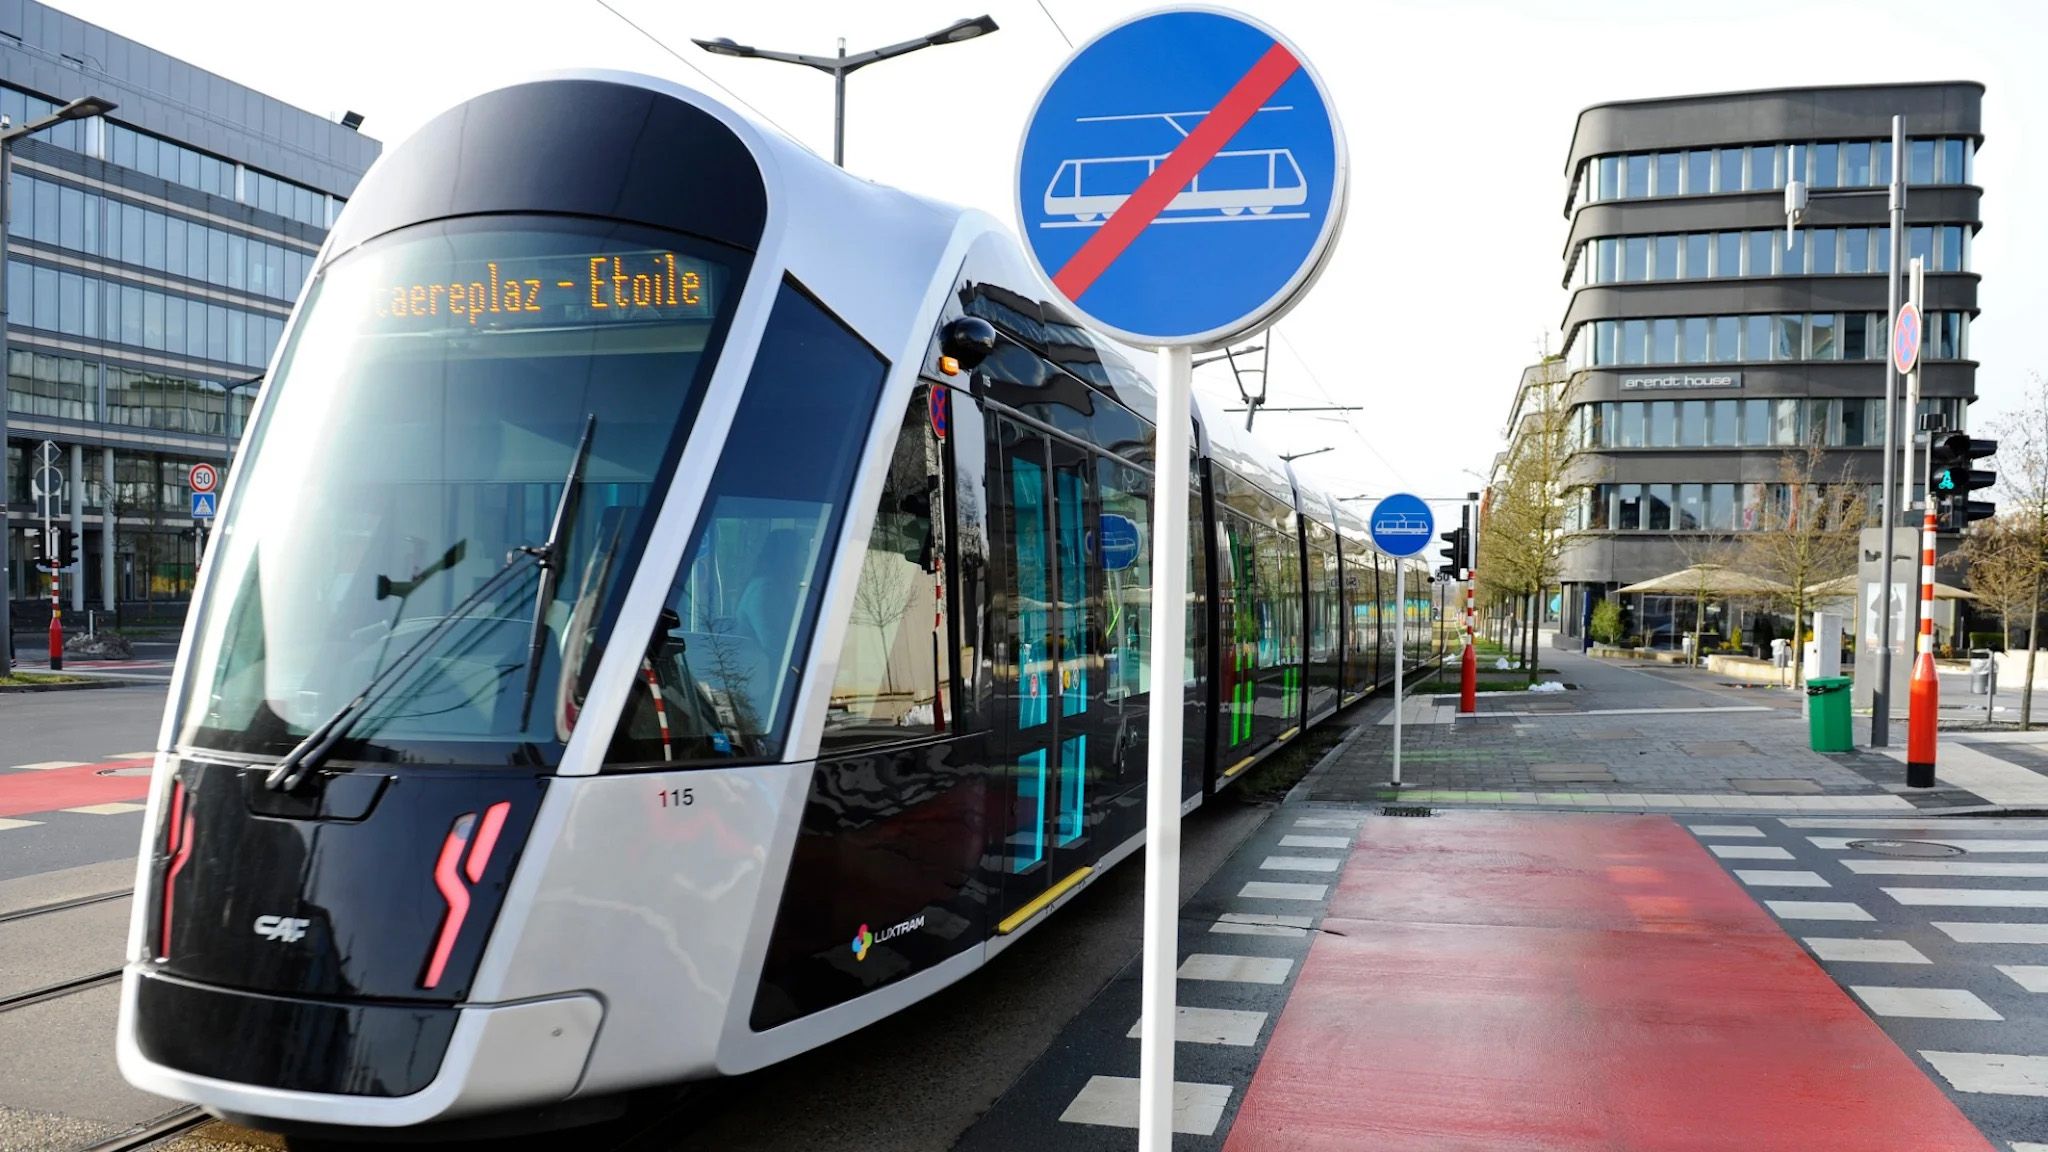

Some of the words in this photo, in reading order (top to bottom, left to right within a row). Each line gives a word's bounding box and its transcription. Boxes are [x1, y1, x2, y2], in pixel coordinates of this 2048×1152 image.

[590, 252, 701, 308] Etoile
[1625, 376, 1680, 387] arendt
[1684, 375, 1732, 386] house
[196, 472, 211, 485] 50
[1436, 572, 1450, 582] 50
[658, 788, 694, 808] 115
[253, 915, 311, 942] CAF
[874, 915, 925, 943] LUXTRAM
